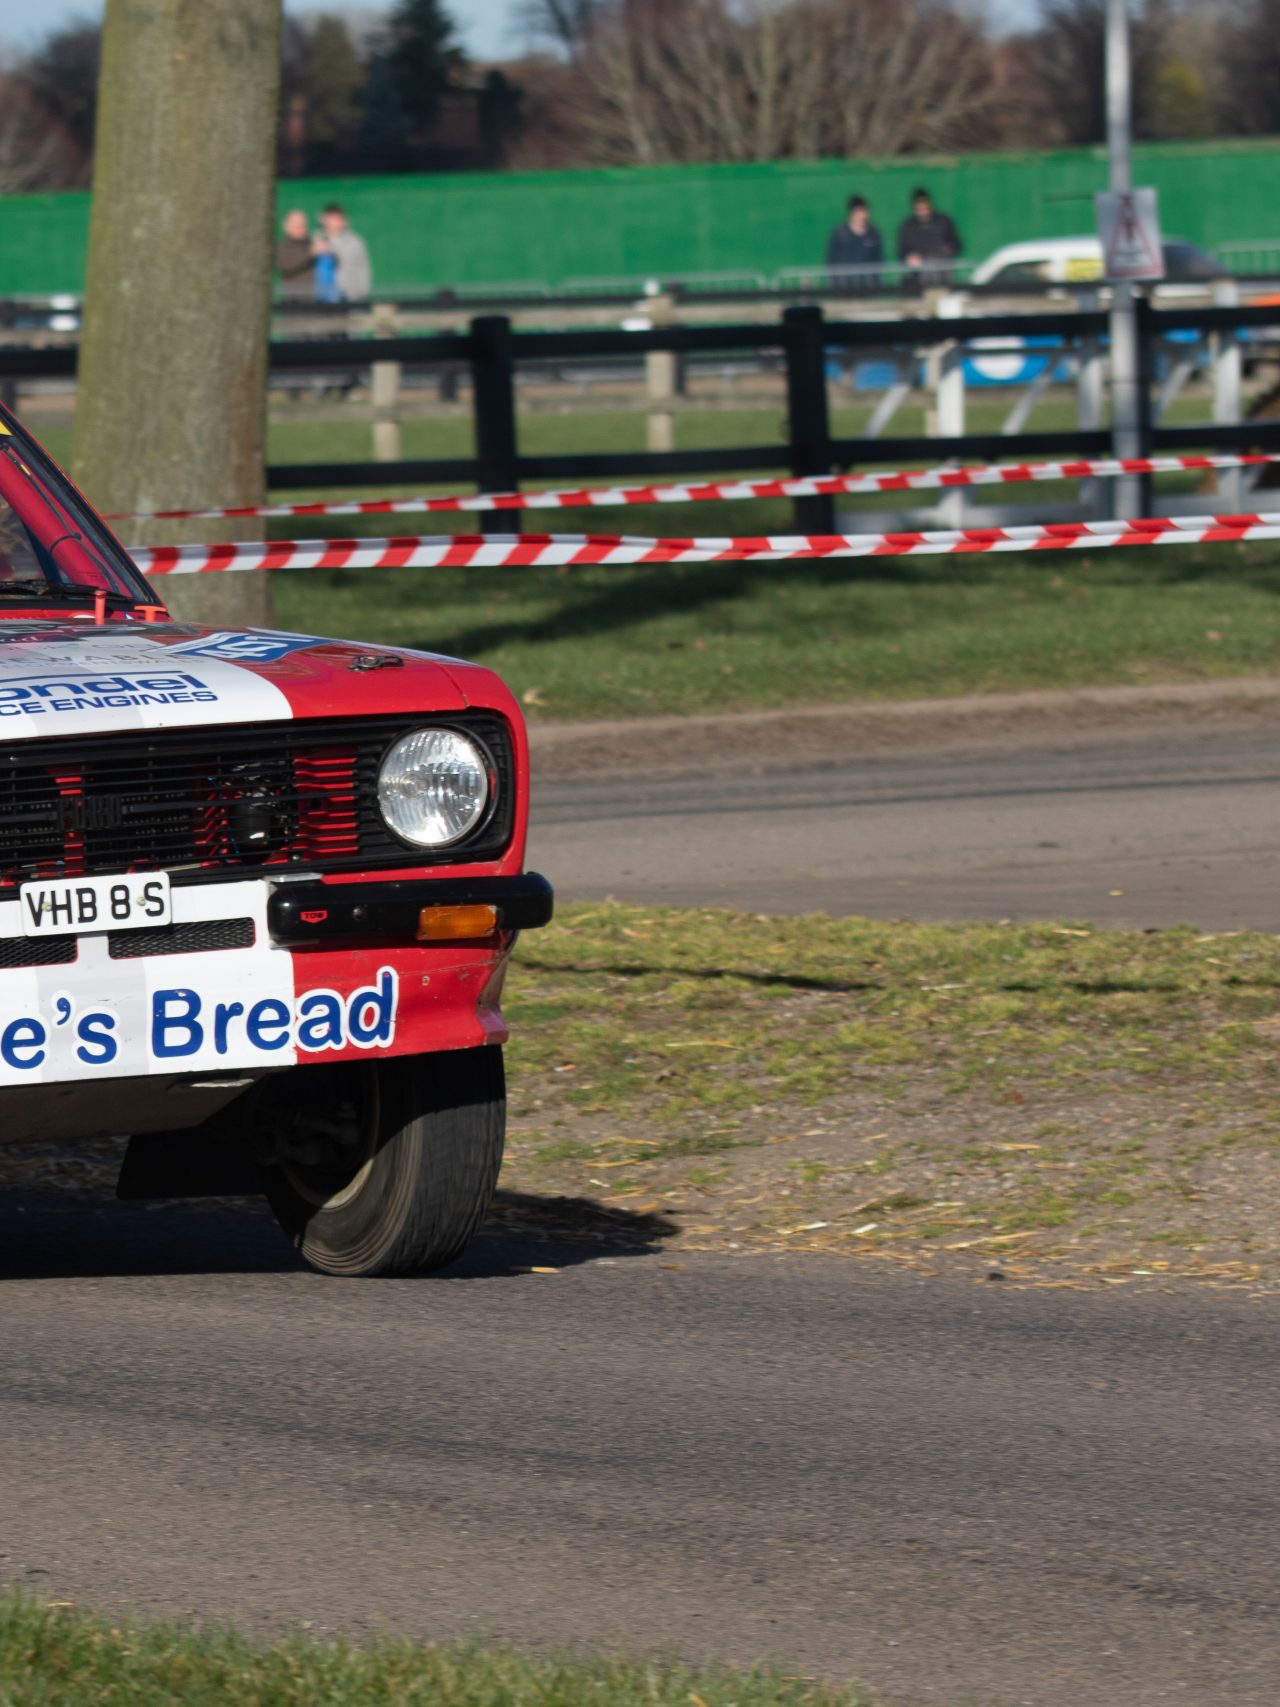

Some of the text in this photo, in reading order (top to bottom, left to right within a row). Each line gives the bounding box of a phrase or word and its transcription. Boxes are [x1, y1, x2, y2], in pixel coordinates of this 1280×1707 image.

[53, 690, 218, 712] ENGINES
[26, 880, 166, 929] VHB 8 S
[150, 970, 397, 1060] Bread
